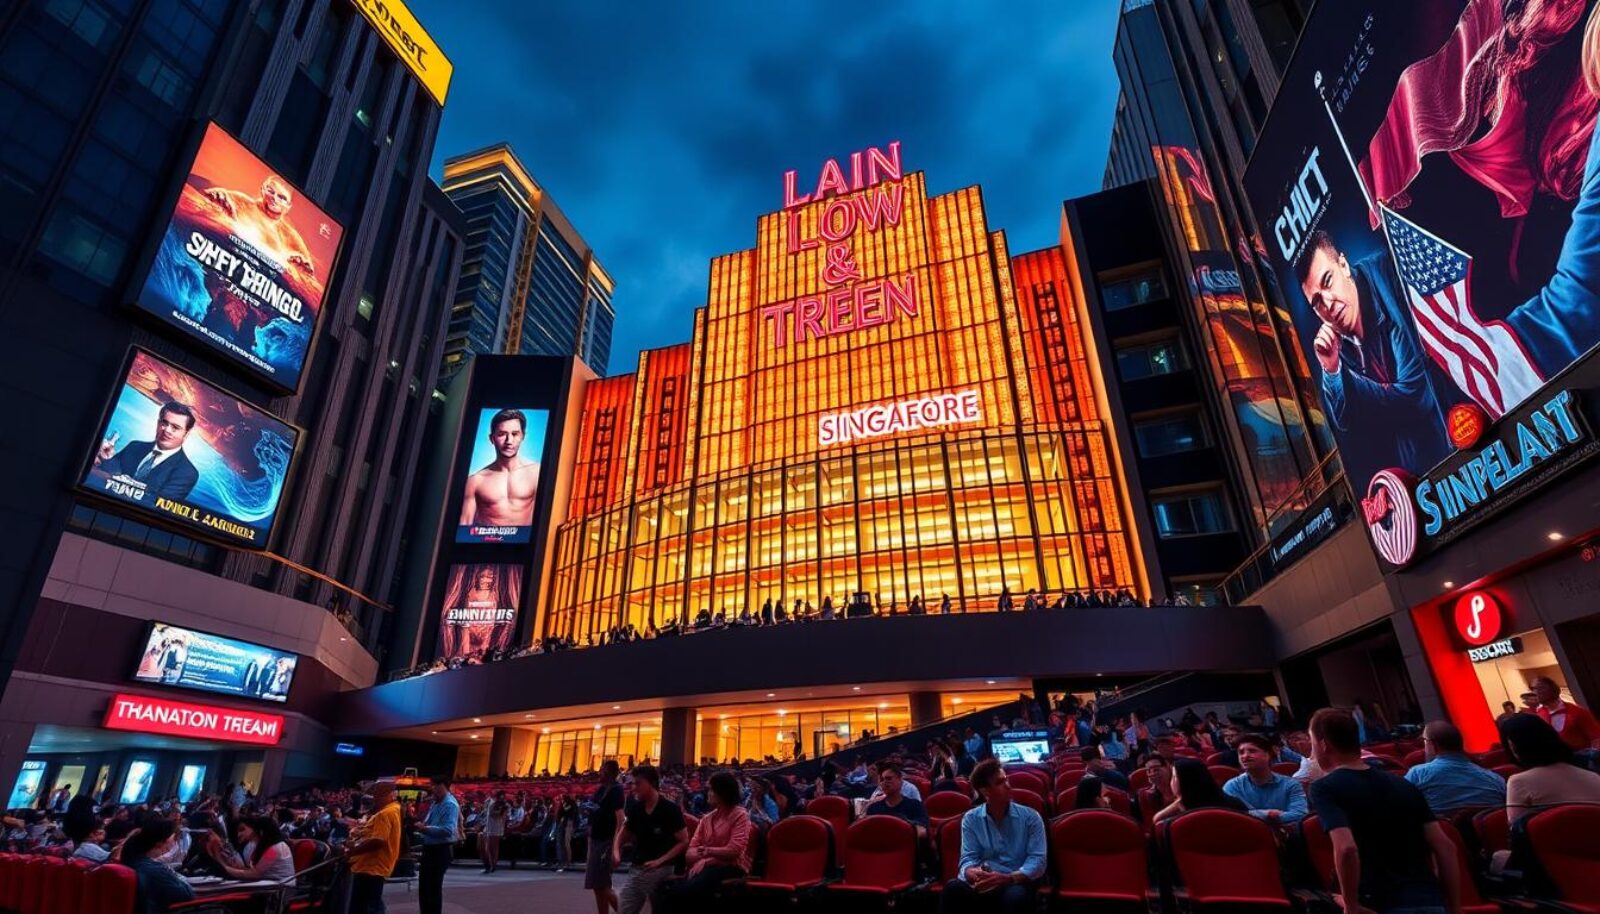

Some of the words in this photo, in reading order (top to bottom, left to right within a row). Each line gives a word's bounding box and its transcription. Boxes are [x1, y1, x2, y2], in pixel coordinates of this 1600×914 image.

[783, 141, 901, 208] LAIN
[1274, 145, 1329, 262] CHICT
[788, 184, 904, 255] LOW
[823, 243, 861, 284] &
[762, 273, 919, 348] TREEN
[818, 390, 981, 445] SINGAFORE
